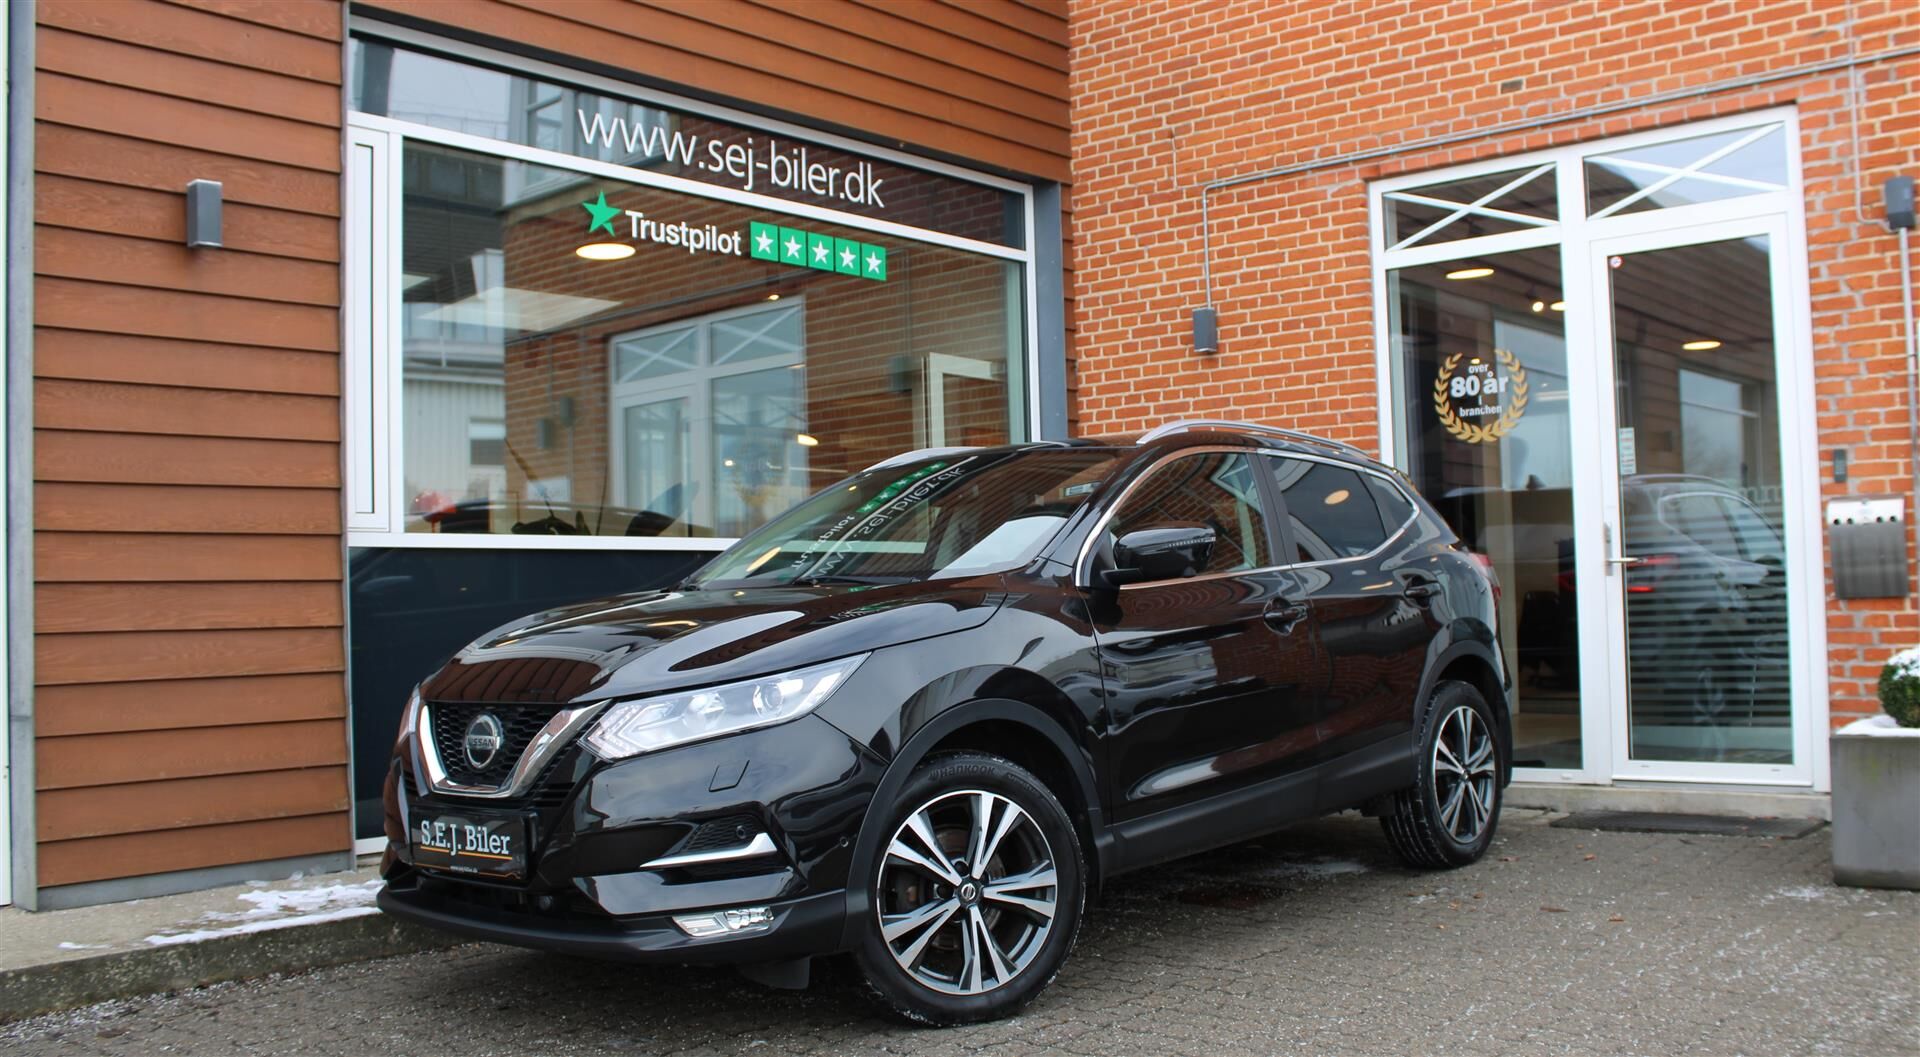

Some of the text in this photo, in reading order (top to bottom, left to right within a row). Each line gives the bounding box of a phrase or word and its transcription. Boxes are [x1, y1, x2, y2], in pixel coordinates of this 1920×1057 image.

[577, 108, 885, 208] www.sej-biler.dk
[625, 210, 742, 255] Trustpilot
[1451, 371, 1508, 397] 80 år
[1469, 364, 1489, 373] over
[1459, 405, 1502, 416] branchen
[421, 820, 511, 856] S.E.J. Biler
